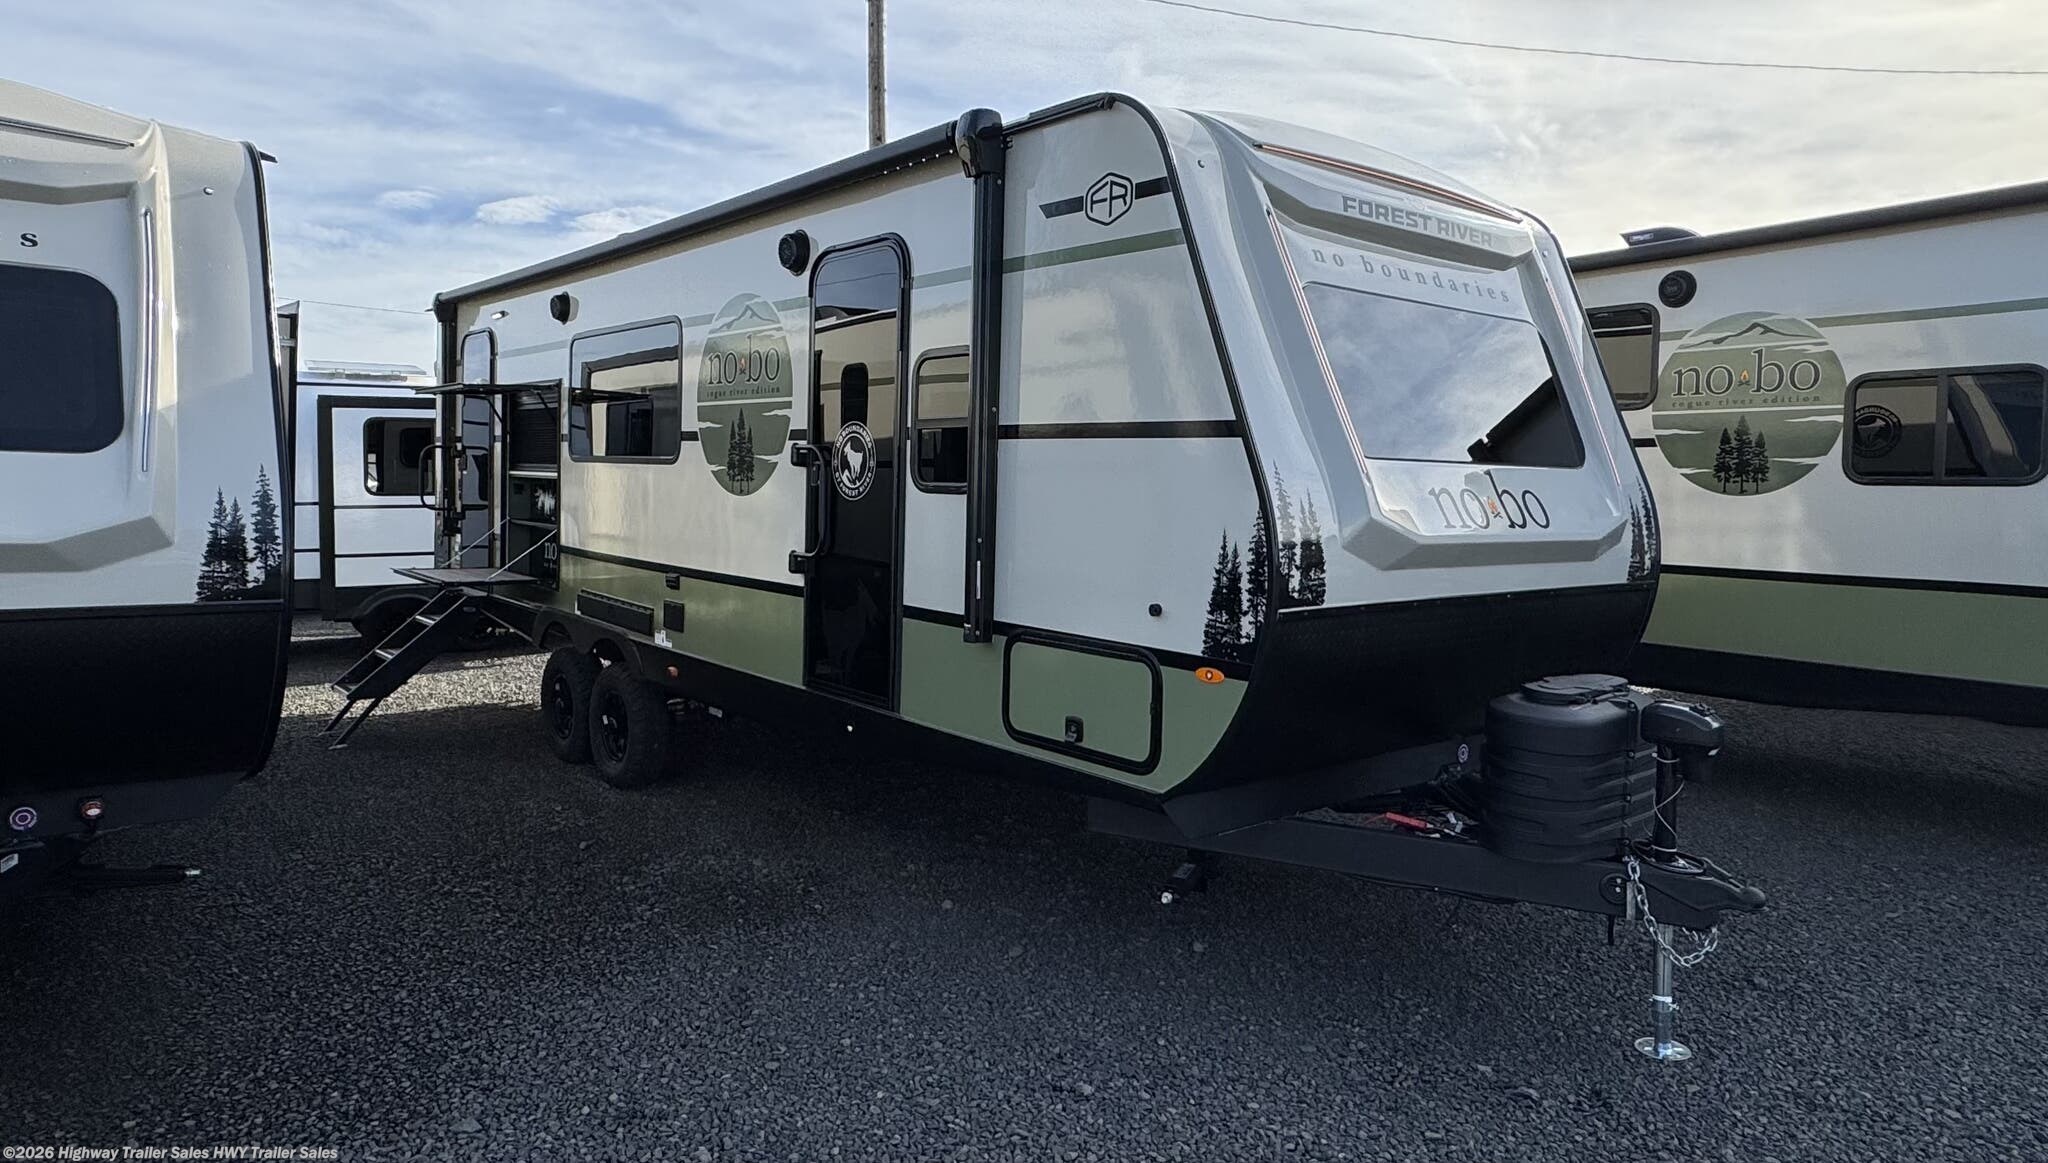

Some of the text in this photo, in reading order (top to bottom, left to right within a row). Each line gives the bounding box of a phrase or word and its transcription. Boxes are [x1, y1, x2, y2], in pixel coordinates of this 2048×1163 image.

[1341, 195, 1494, 247] FOREST RIVER
[1311, 249, 1511, 303] no boundaries
[1671, 395, 1821, 409] rogue river edition
